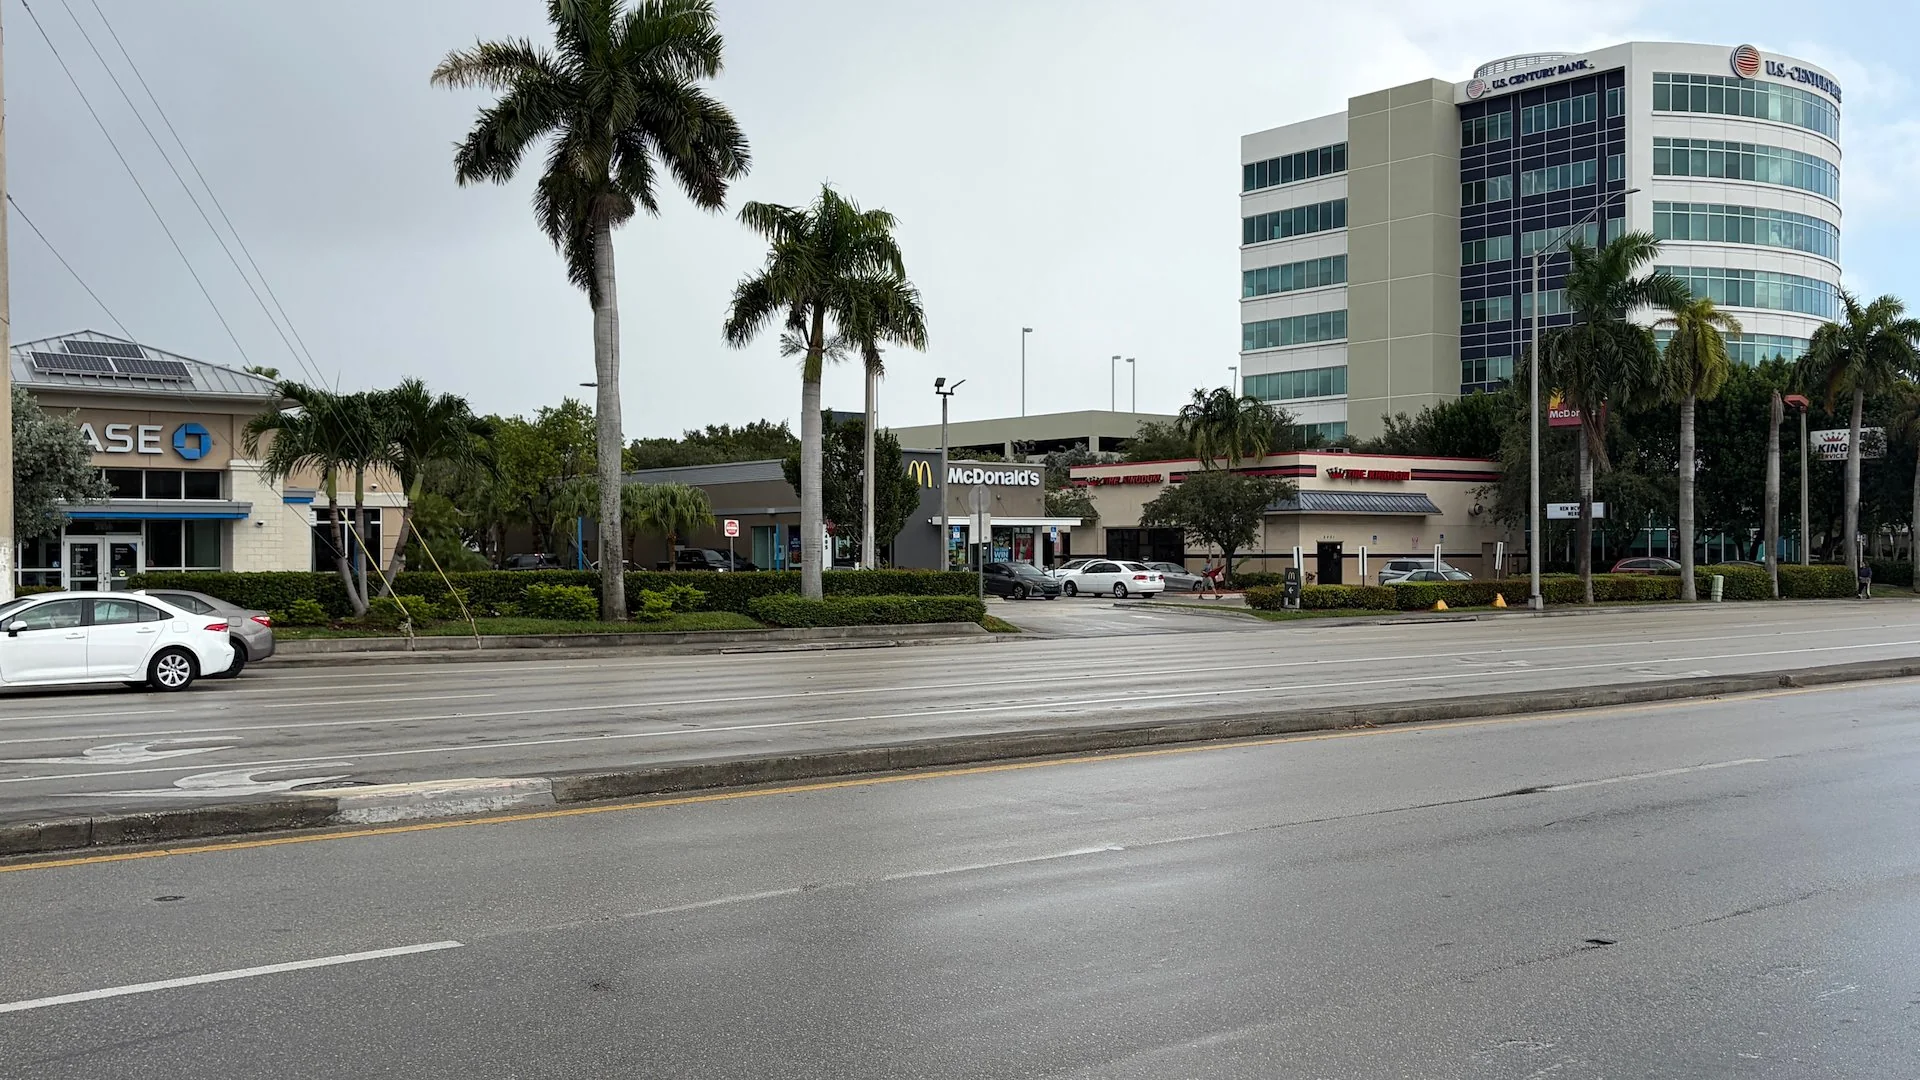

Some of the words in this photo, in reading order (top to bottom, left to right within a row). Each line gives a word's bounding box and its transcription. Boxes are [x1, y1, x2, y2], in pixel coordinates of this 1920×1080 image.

[1492, 80, 1508, 89] U.S.
[1509, 68, 1557, 85] CENTURY
[1558, 60, 1588, 75] BANK
[79, 422, 165, 454] ASE
[1818, 443, 1849, 453] KING
[947, 467, 1040, 486] McDonald's
